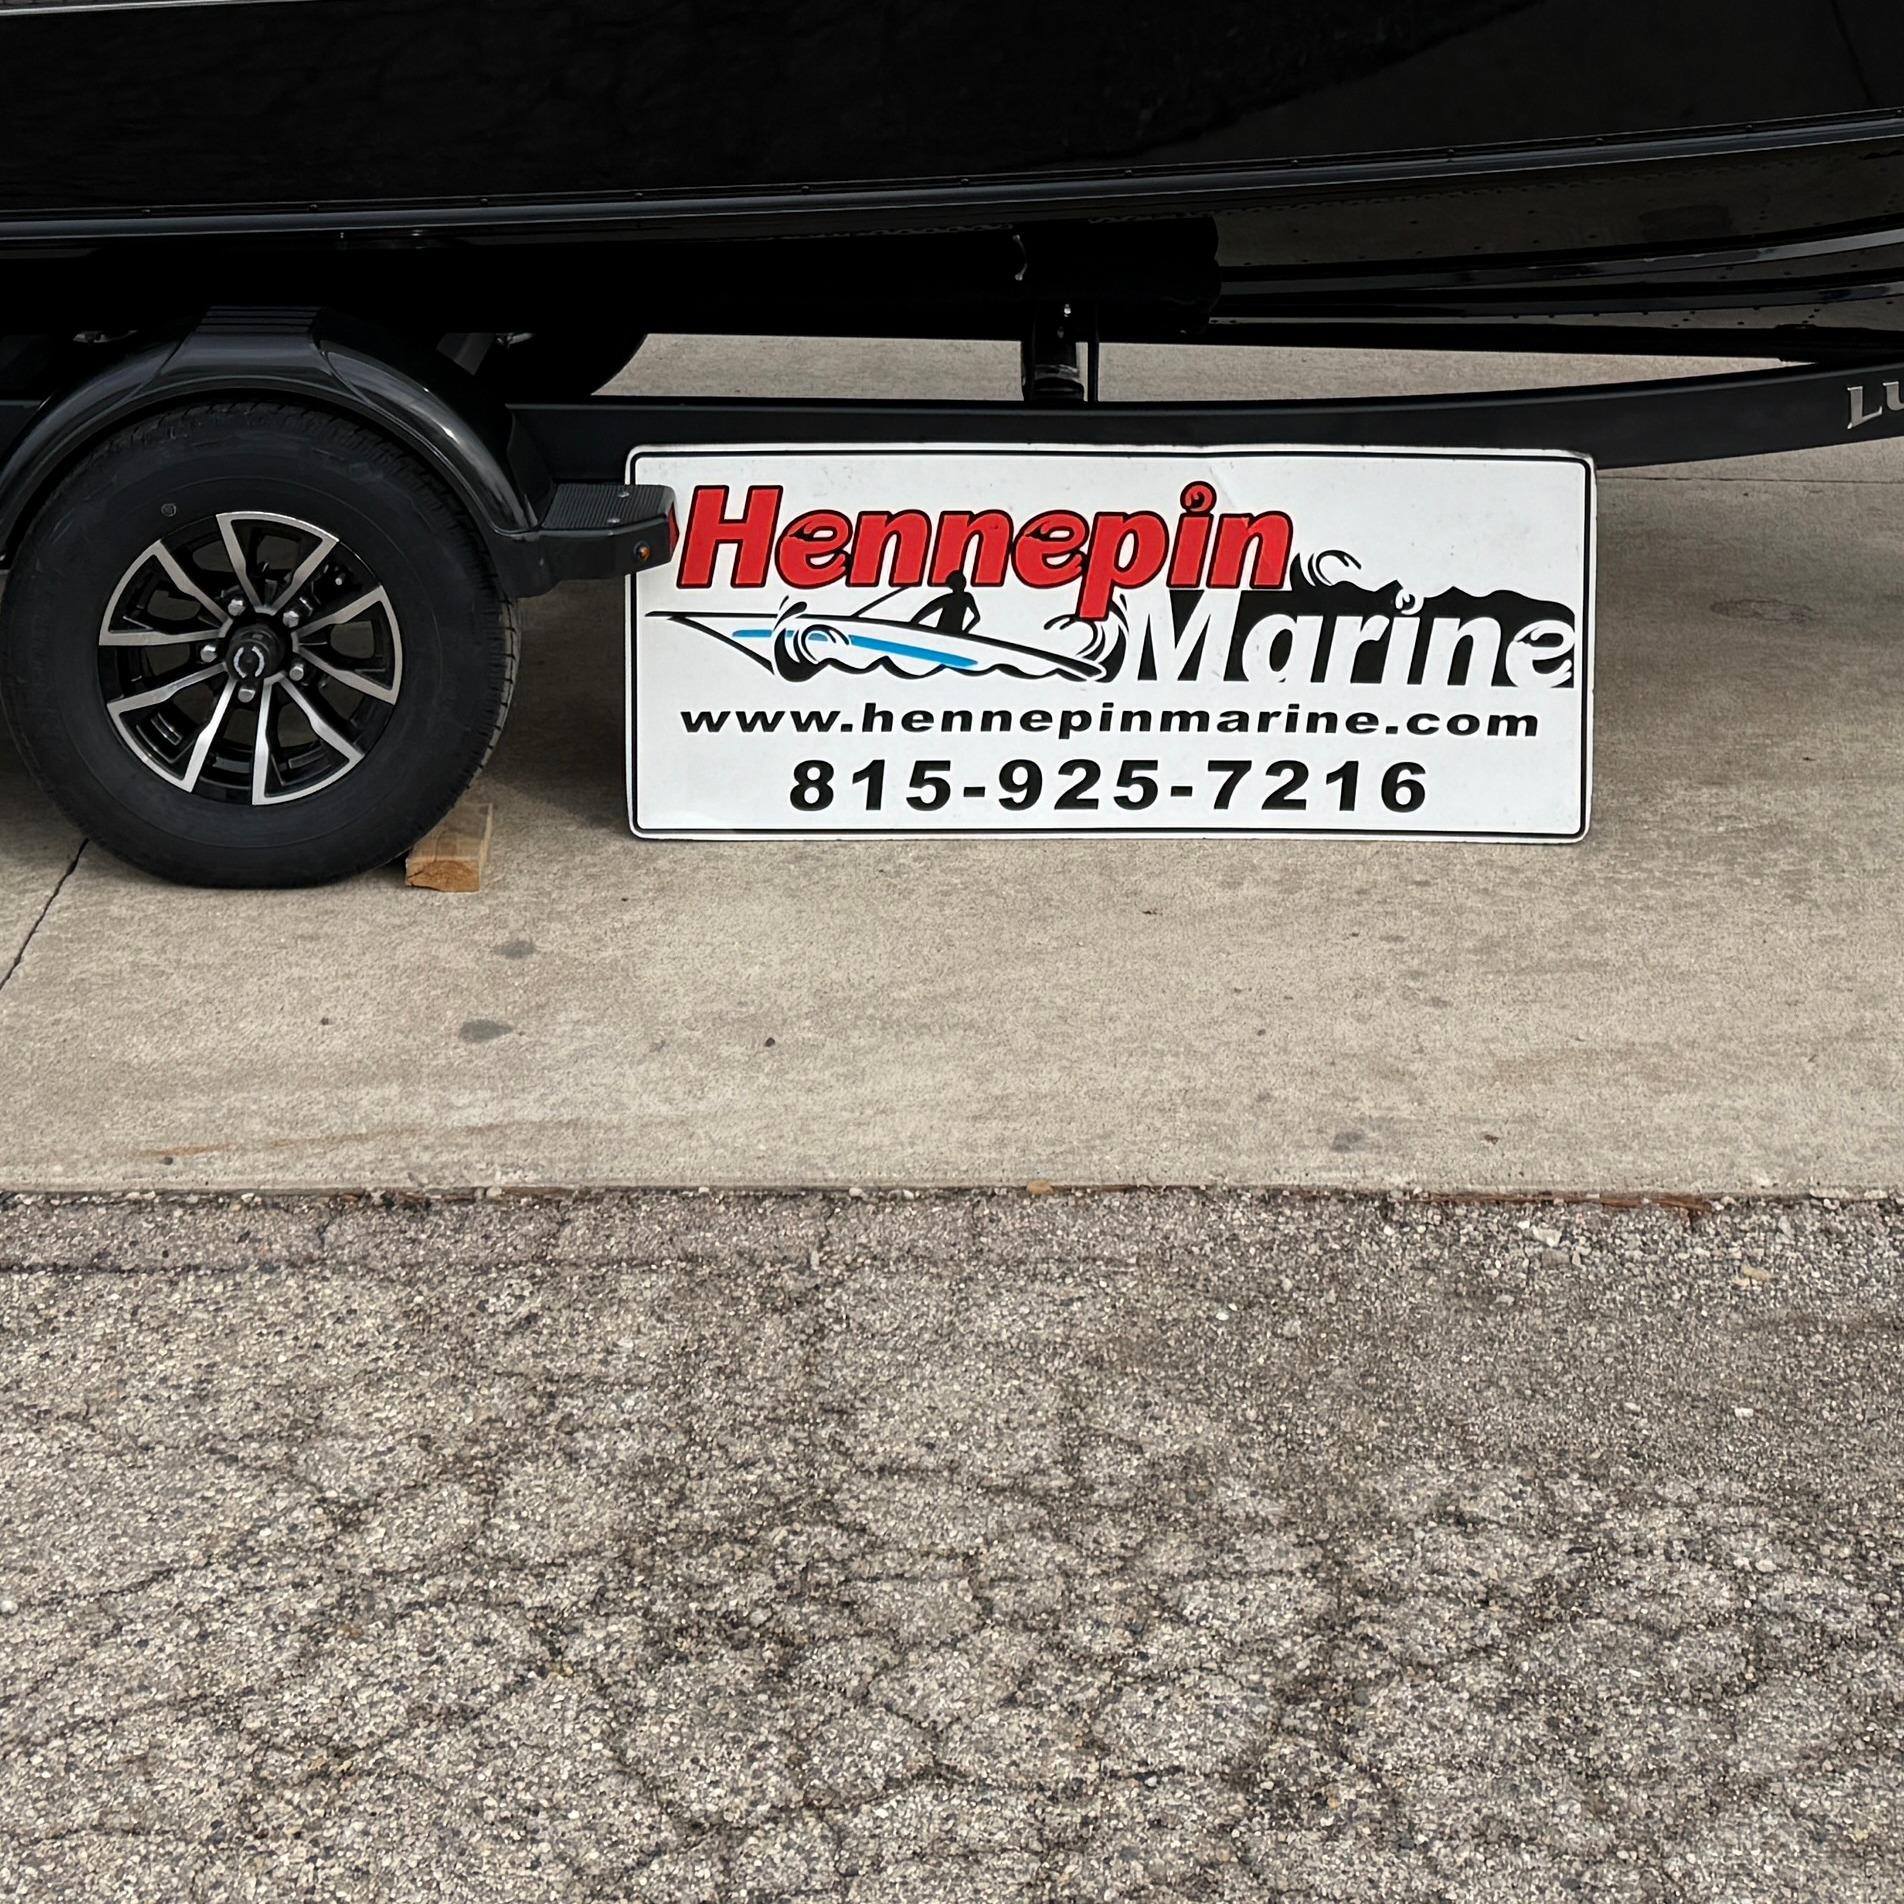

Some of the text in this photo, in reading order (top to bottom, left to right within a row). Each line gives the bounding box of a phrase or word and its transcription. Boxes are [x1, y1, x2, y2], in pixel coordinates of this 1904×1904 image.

[677, 482, 1295, 620] Hennepin
[1122, 584, 1576, 689] Marine
[680, 701, 1539, 739] www.hennepinmarine.com
[789, 758, 1428, 814] 815-925-7216
